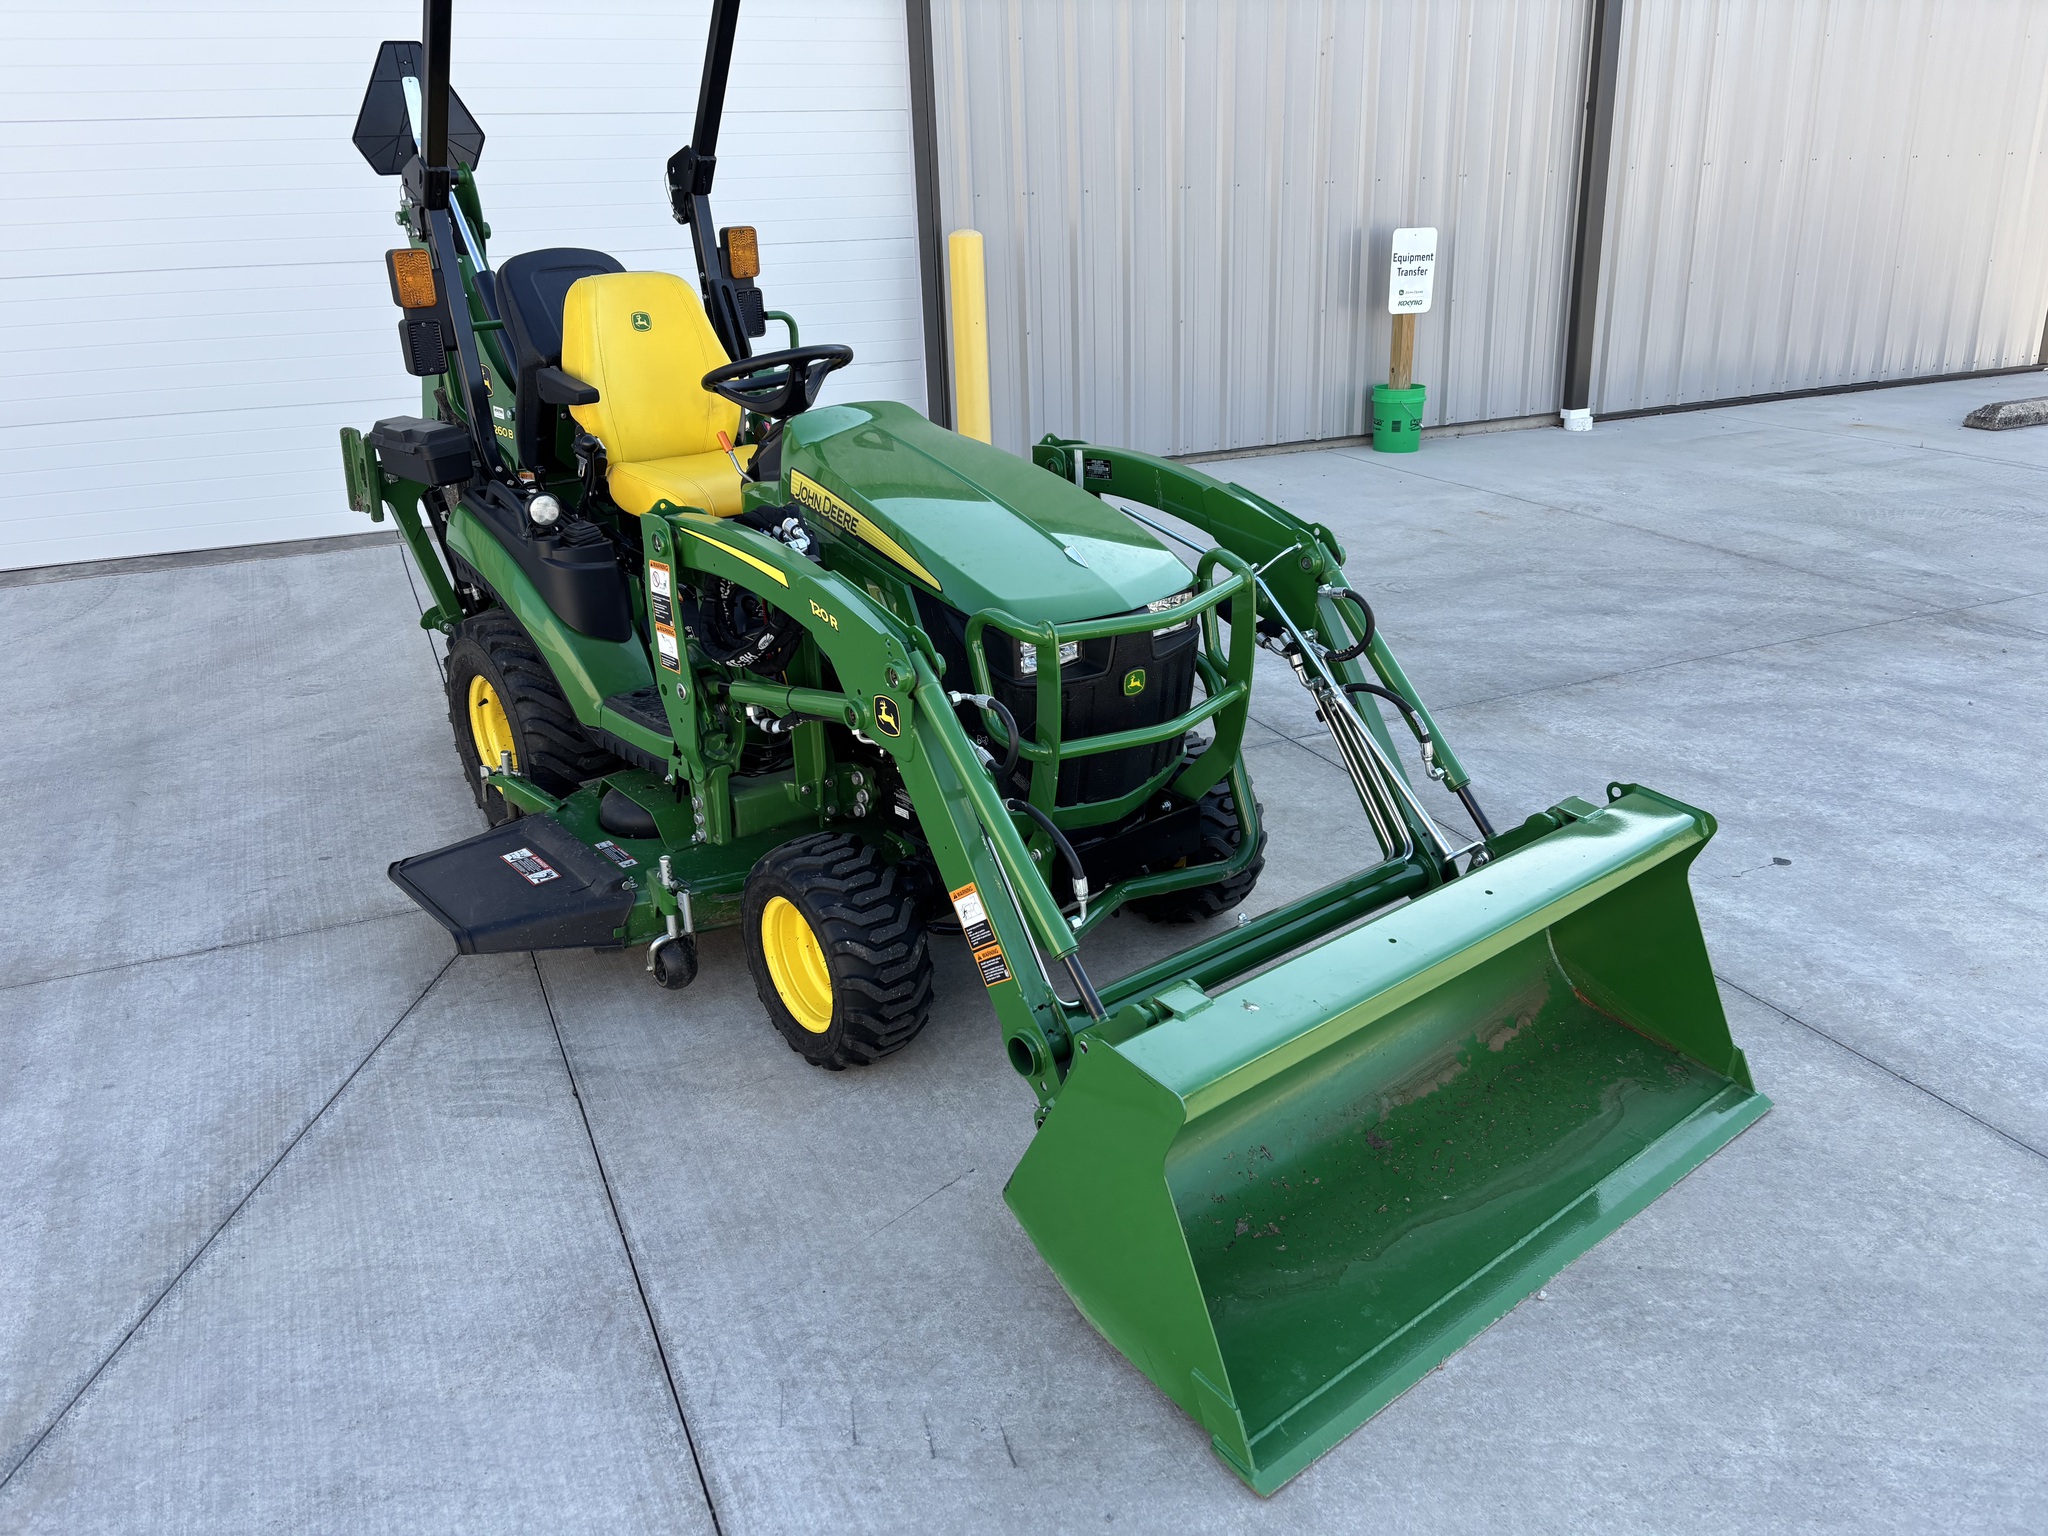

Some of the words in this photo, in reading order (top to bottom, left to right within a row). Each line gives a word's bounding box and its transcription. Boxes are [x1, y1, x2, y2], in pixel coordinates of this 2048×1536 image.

[1392, 252, 1434, 265] Equipment
[1397, 266, 1428, 277] Transfer
[796, 481, 822, 512] JOHN
[823, 496, 859, 534] DEERE
[829, 614, 839, 632] R
[957, 885, 974, 897] WARNING
[981, 948, 999, 958] WARNING
